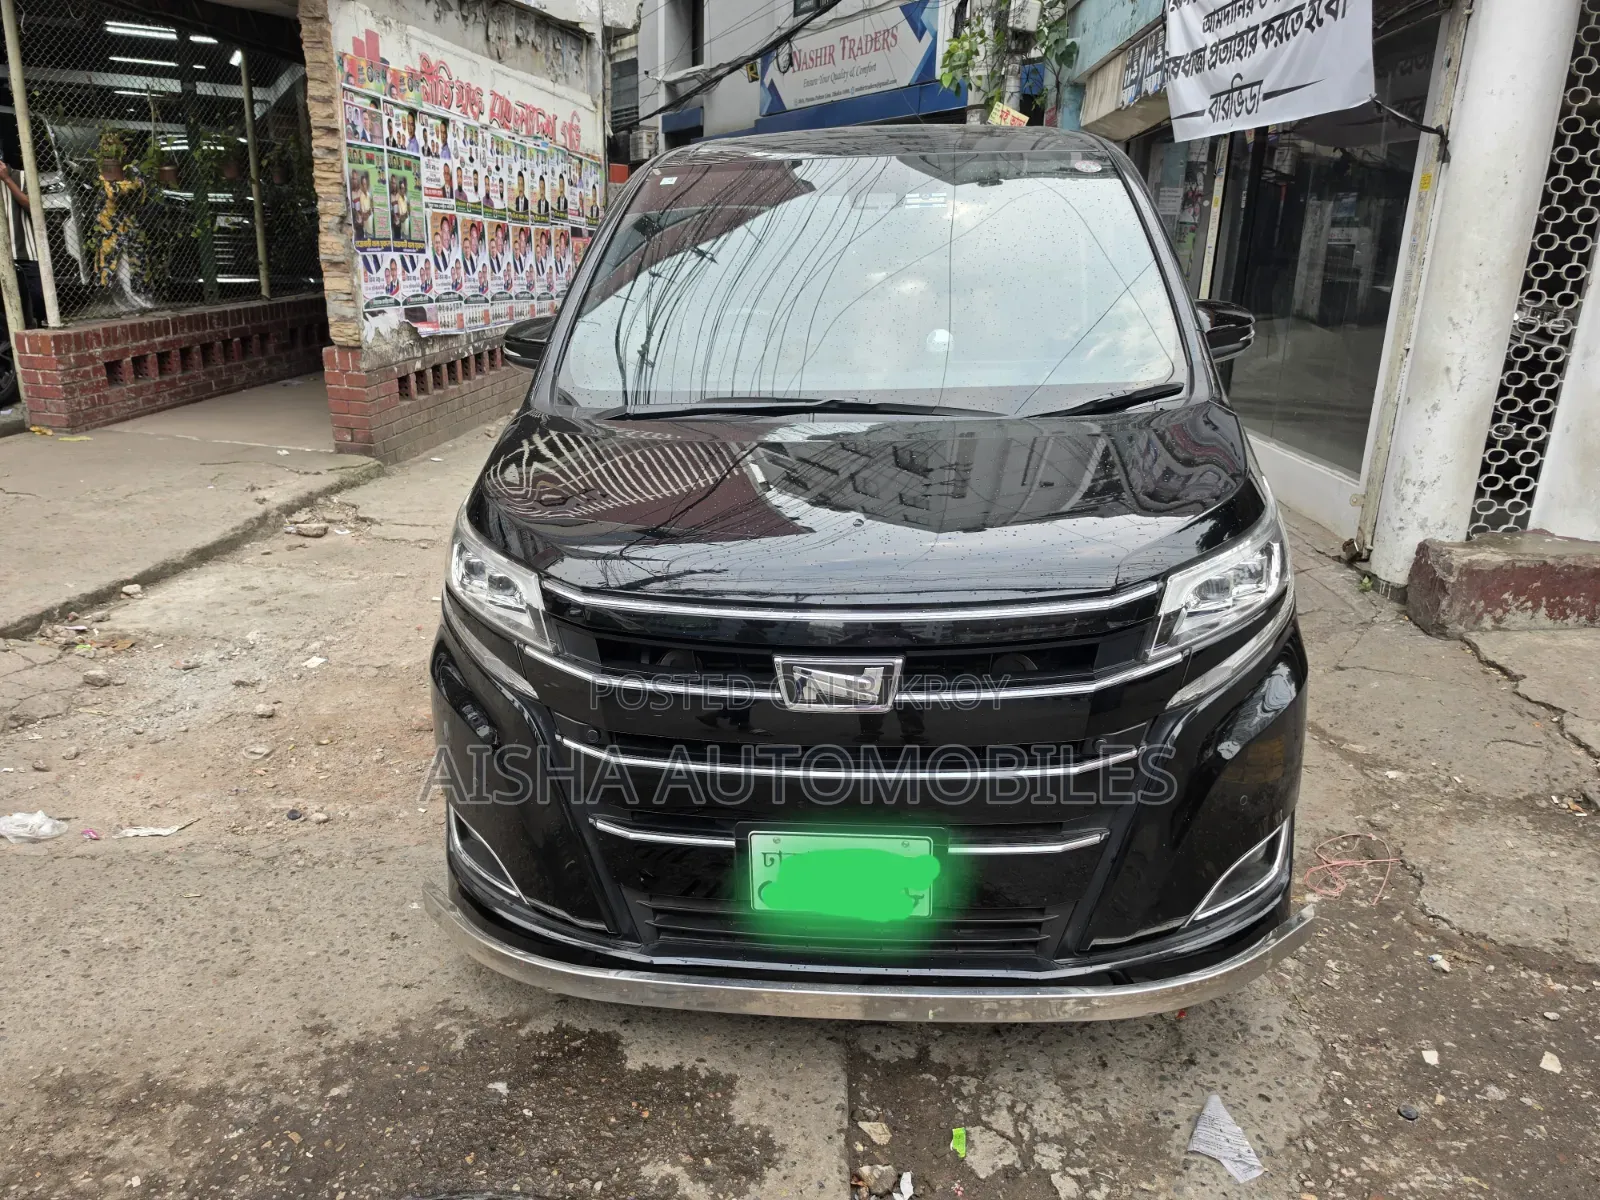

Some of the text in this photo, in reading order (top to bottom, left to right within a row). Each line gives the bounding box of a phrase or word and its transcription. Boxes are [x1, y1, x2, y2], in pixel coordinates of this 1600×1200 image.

[791, 26, 898, 74] NASHIR TRADERS
[1208, 24, 1259, 71] প্রত্যাহার
[1261, 2, 1306, 50] করতে
[1208, 73, 1263, 123] বারভিডা
